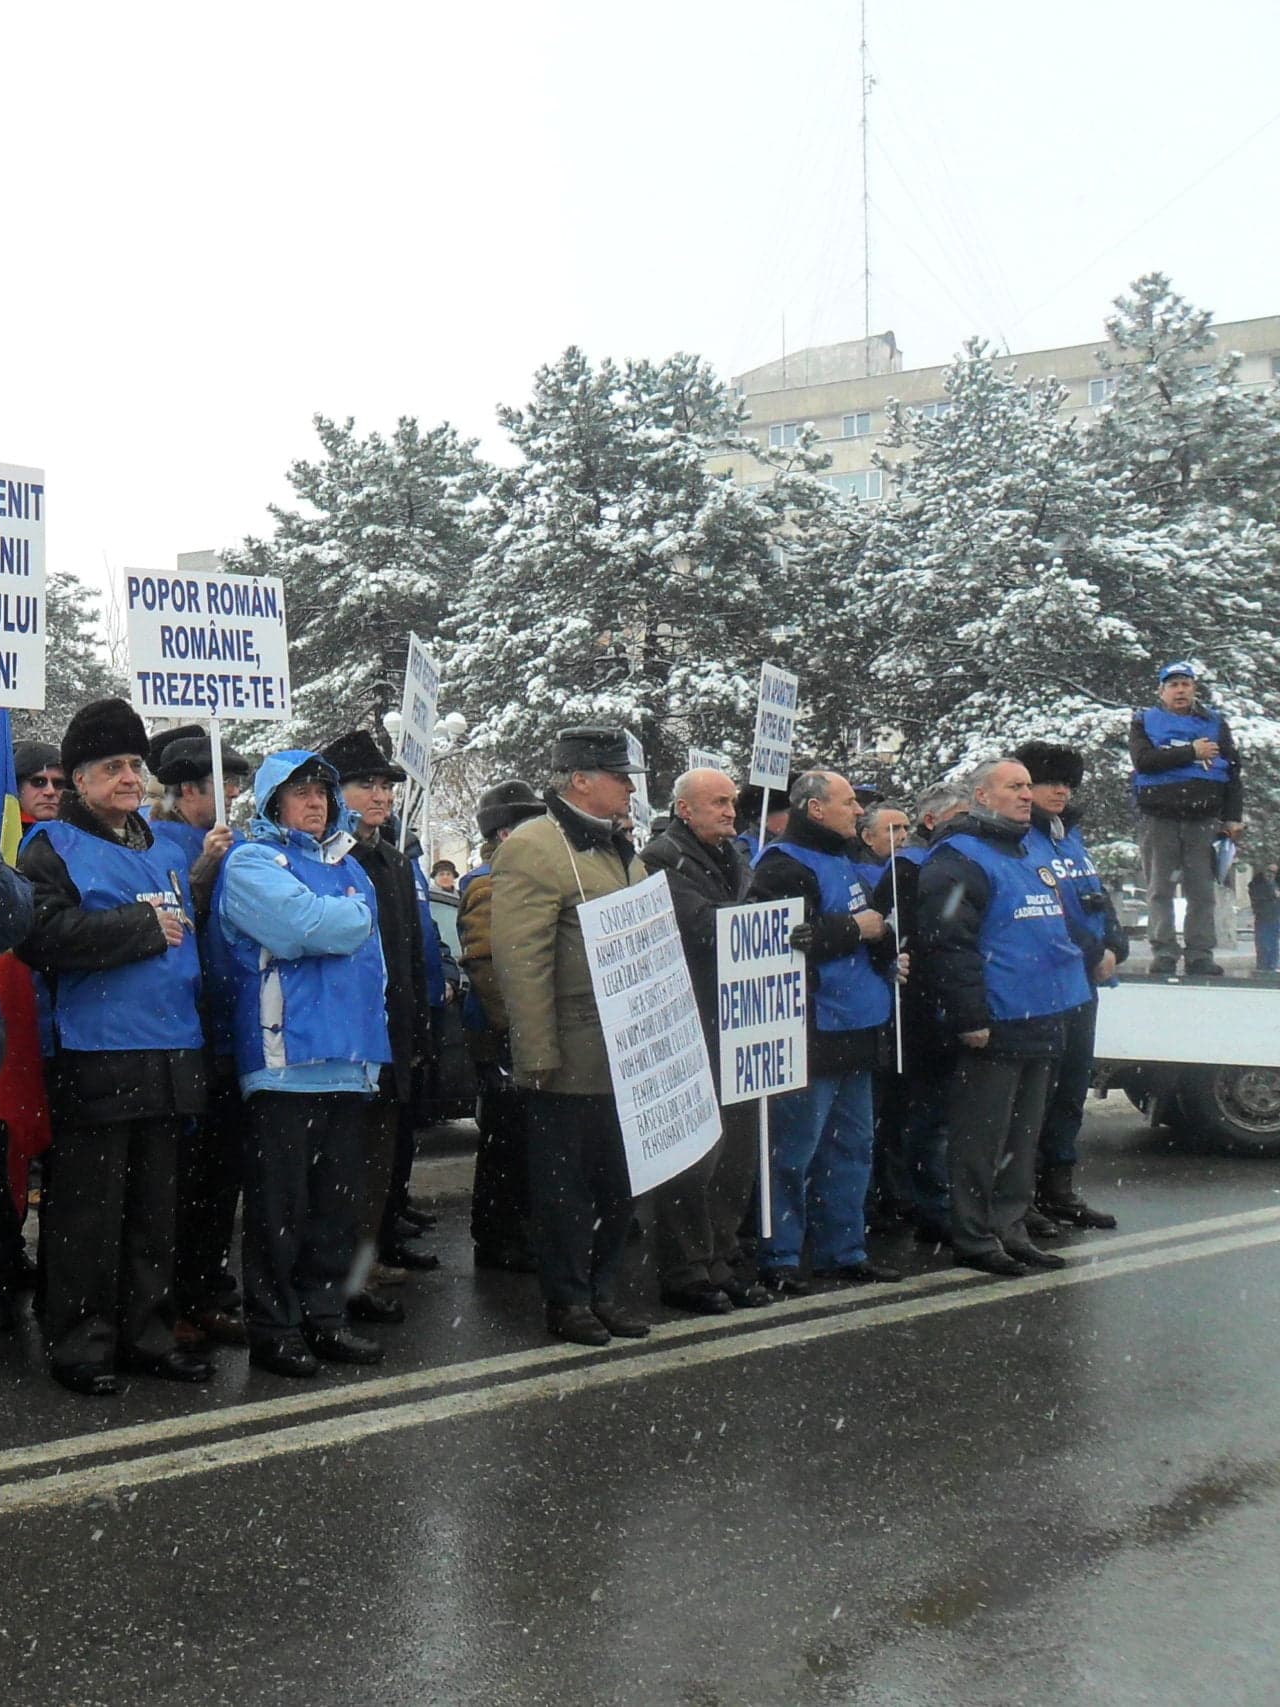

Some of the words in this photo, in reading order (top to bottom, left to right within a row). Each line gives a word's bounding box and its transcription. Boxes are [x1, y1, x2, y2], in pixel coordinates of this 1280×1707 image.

[128, 576, 200, 613] POPOR
[206, 578, 283, 627] ROMÂN,
[161, 620, 260, 670] ROMÂNIE,
[137, 672, 274, 715] TREZEŞTE-TE
[731, 908, 793, 964] ONOARE,
[721, 971, 804, 1031] DEMNITATE,
[736, 1039, 784, 1094] PATRIE
